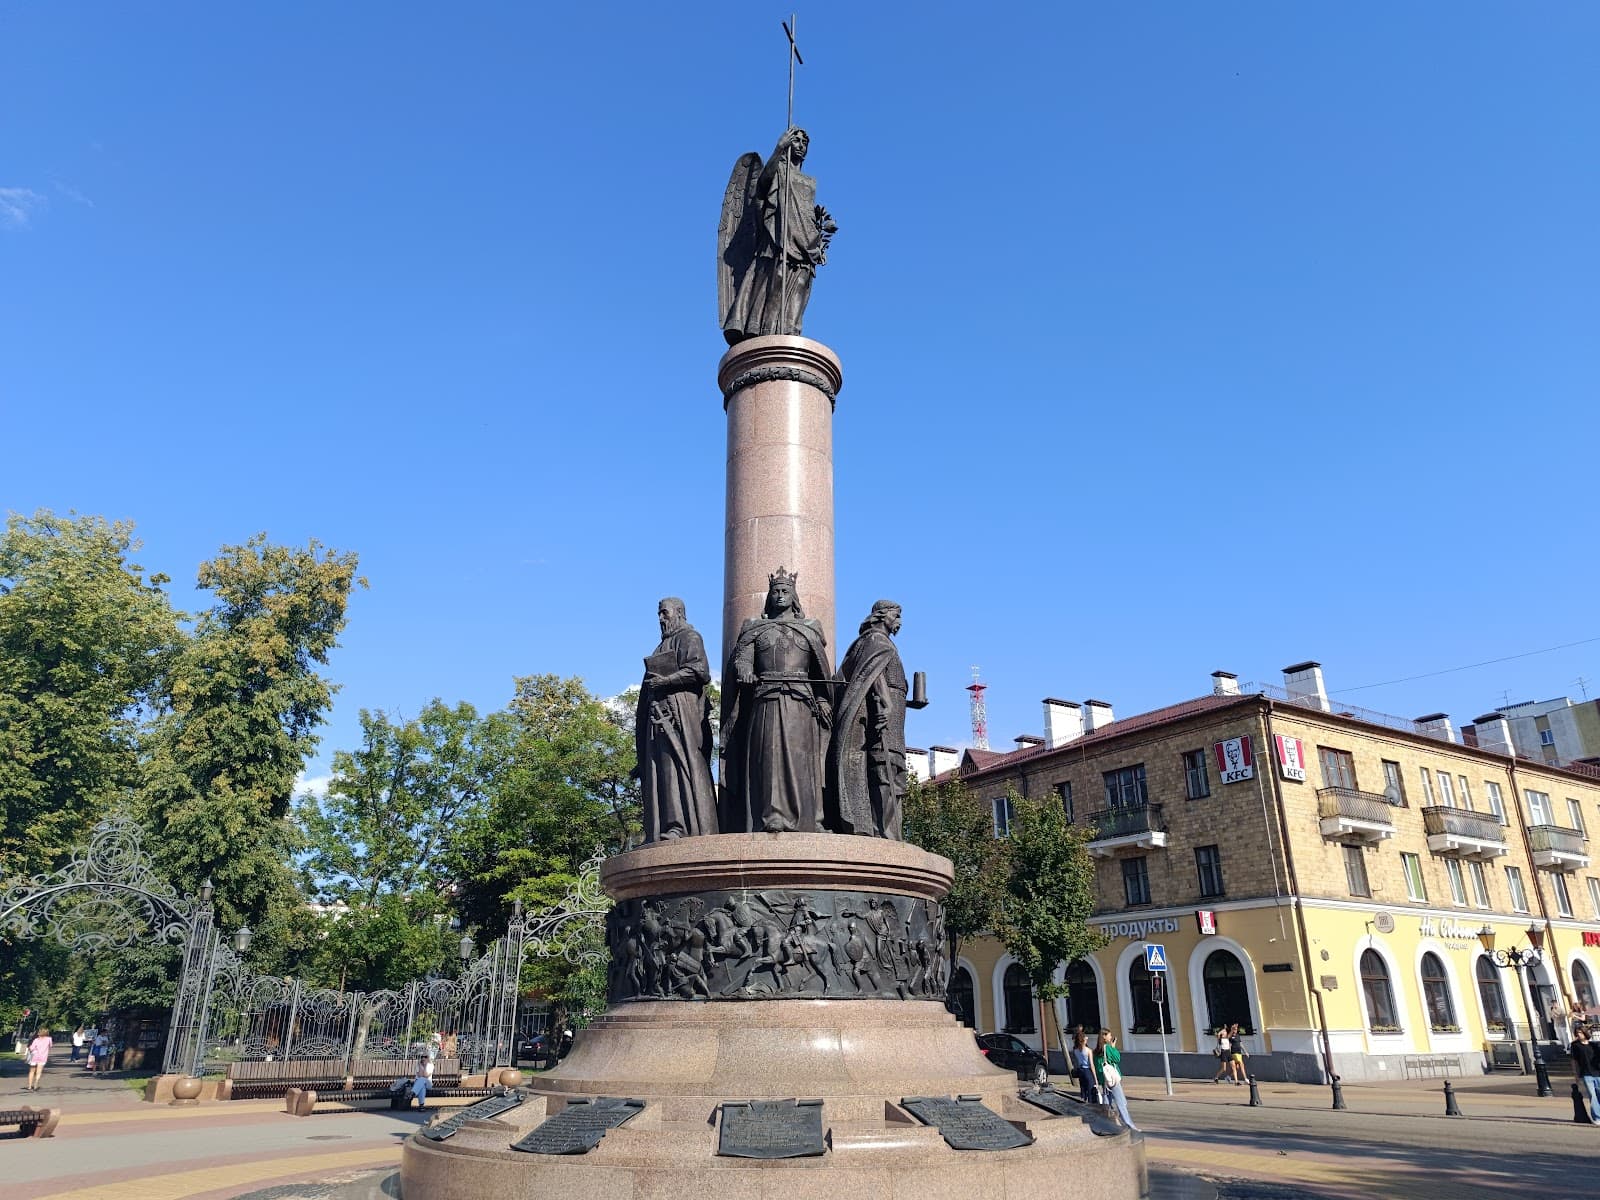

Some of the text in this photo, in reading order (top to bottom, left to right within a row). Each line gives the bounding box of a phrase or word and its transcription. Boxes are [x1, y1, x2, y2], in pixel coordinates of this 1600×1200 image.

[1226, 769, 1248, 781] KFC
[1287, 768, 1303, 779] KFC
[1100, 919, 1179, 941] продукты
